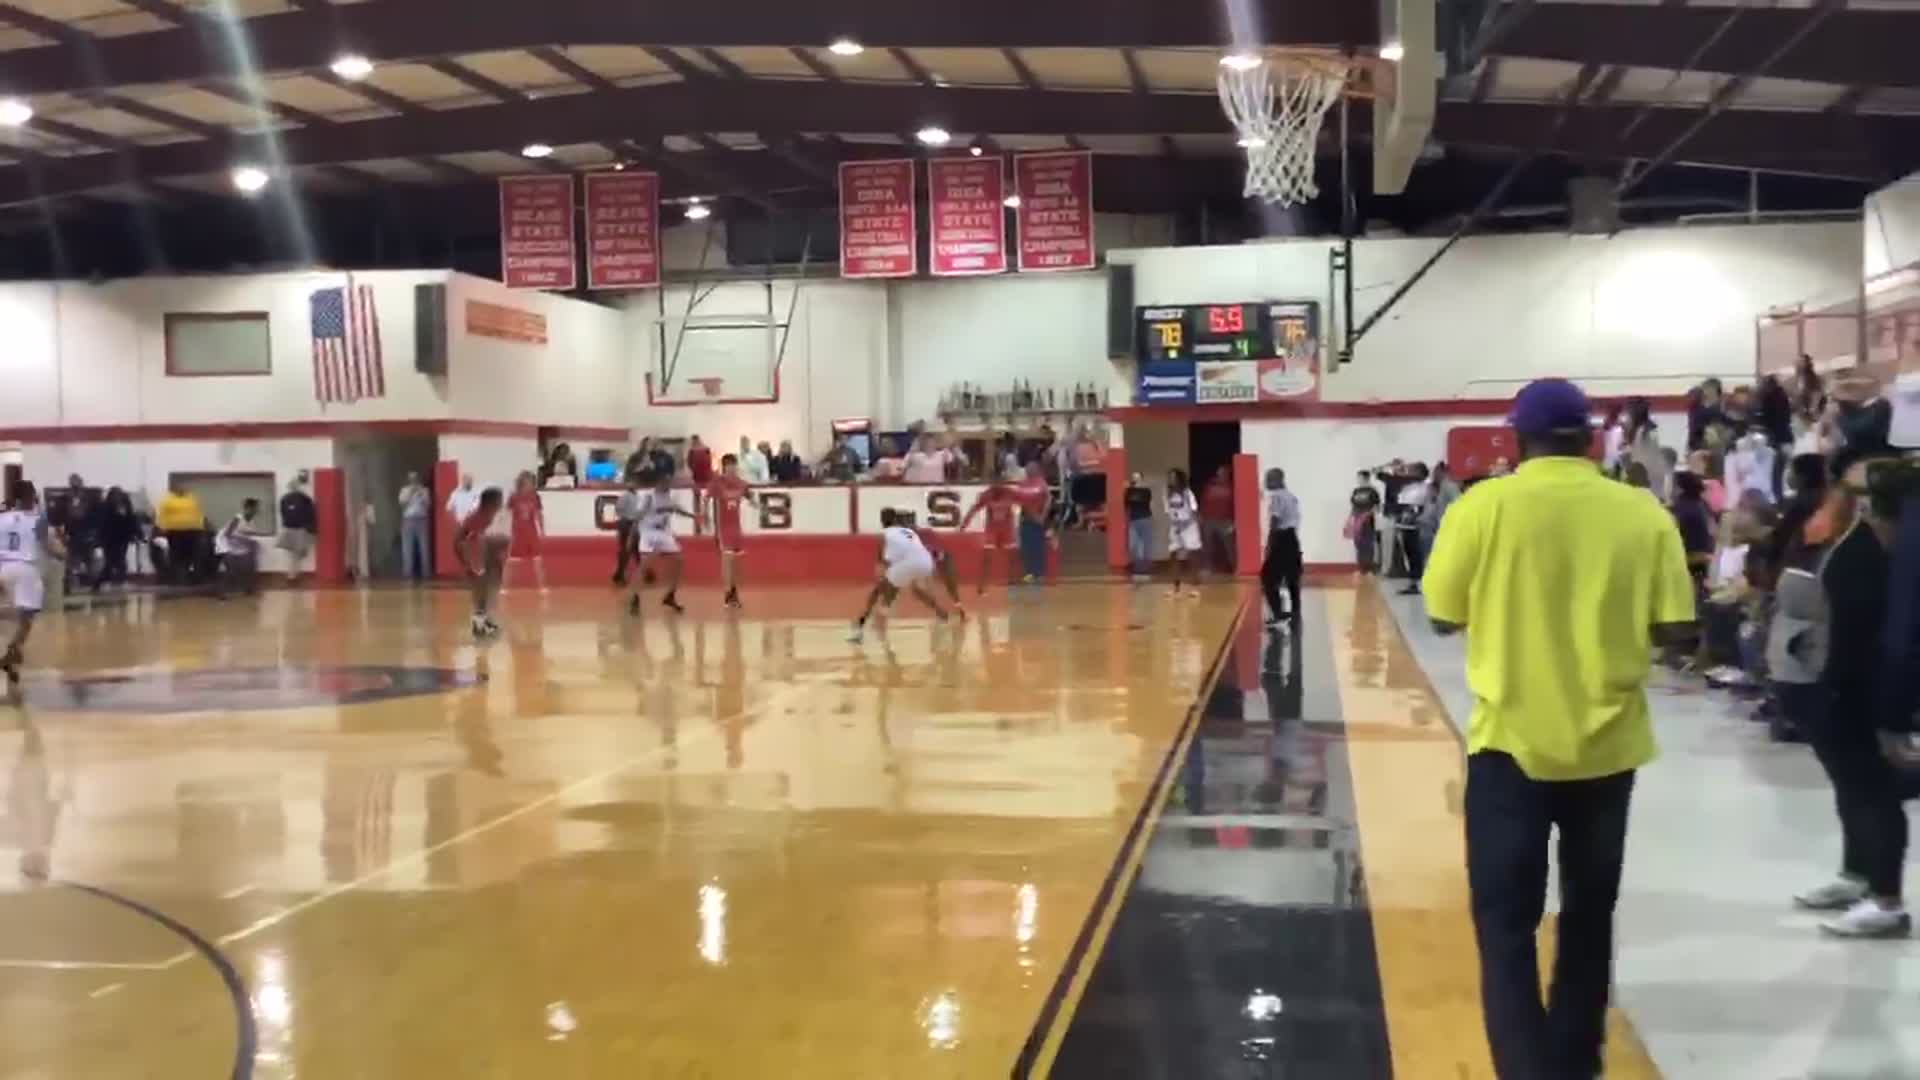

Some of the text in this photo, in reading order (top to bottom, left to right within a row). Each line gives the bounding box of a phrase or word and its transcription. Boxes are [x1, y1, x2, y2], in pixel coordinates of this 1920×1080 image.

[852, 216, 903, 229] STATE
[943, 213, 992, 226] STATE
[1029, 210, 1080, 222] STATE
[596, 223, 648, 235] STATE
[759, 492, 793, 529] B
[927, 491, 961, 528] S
